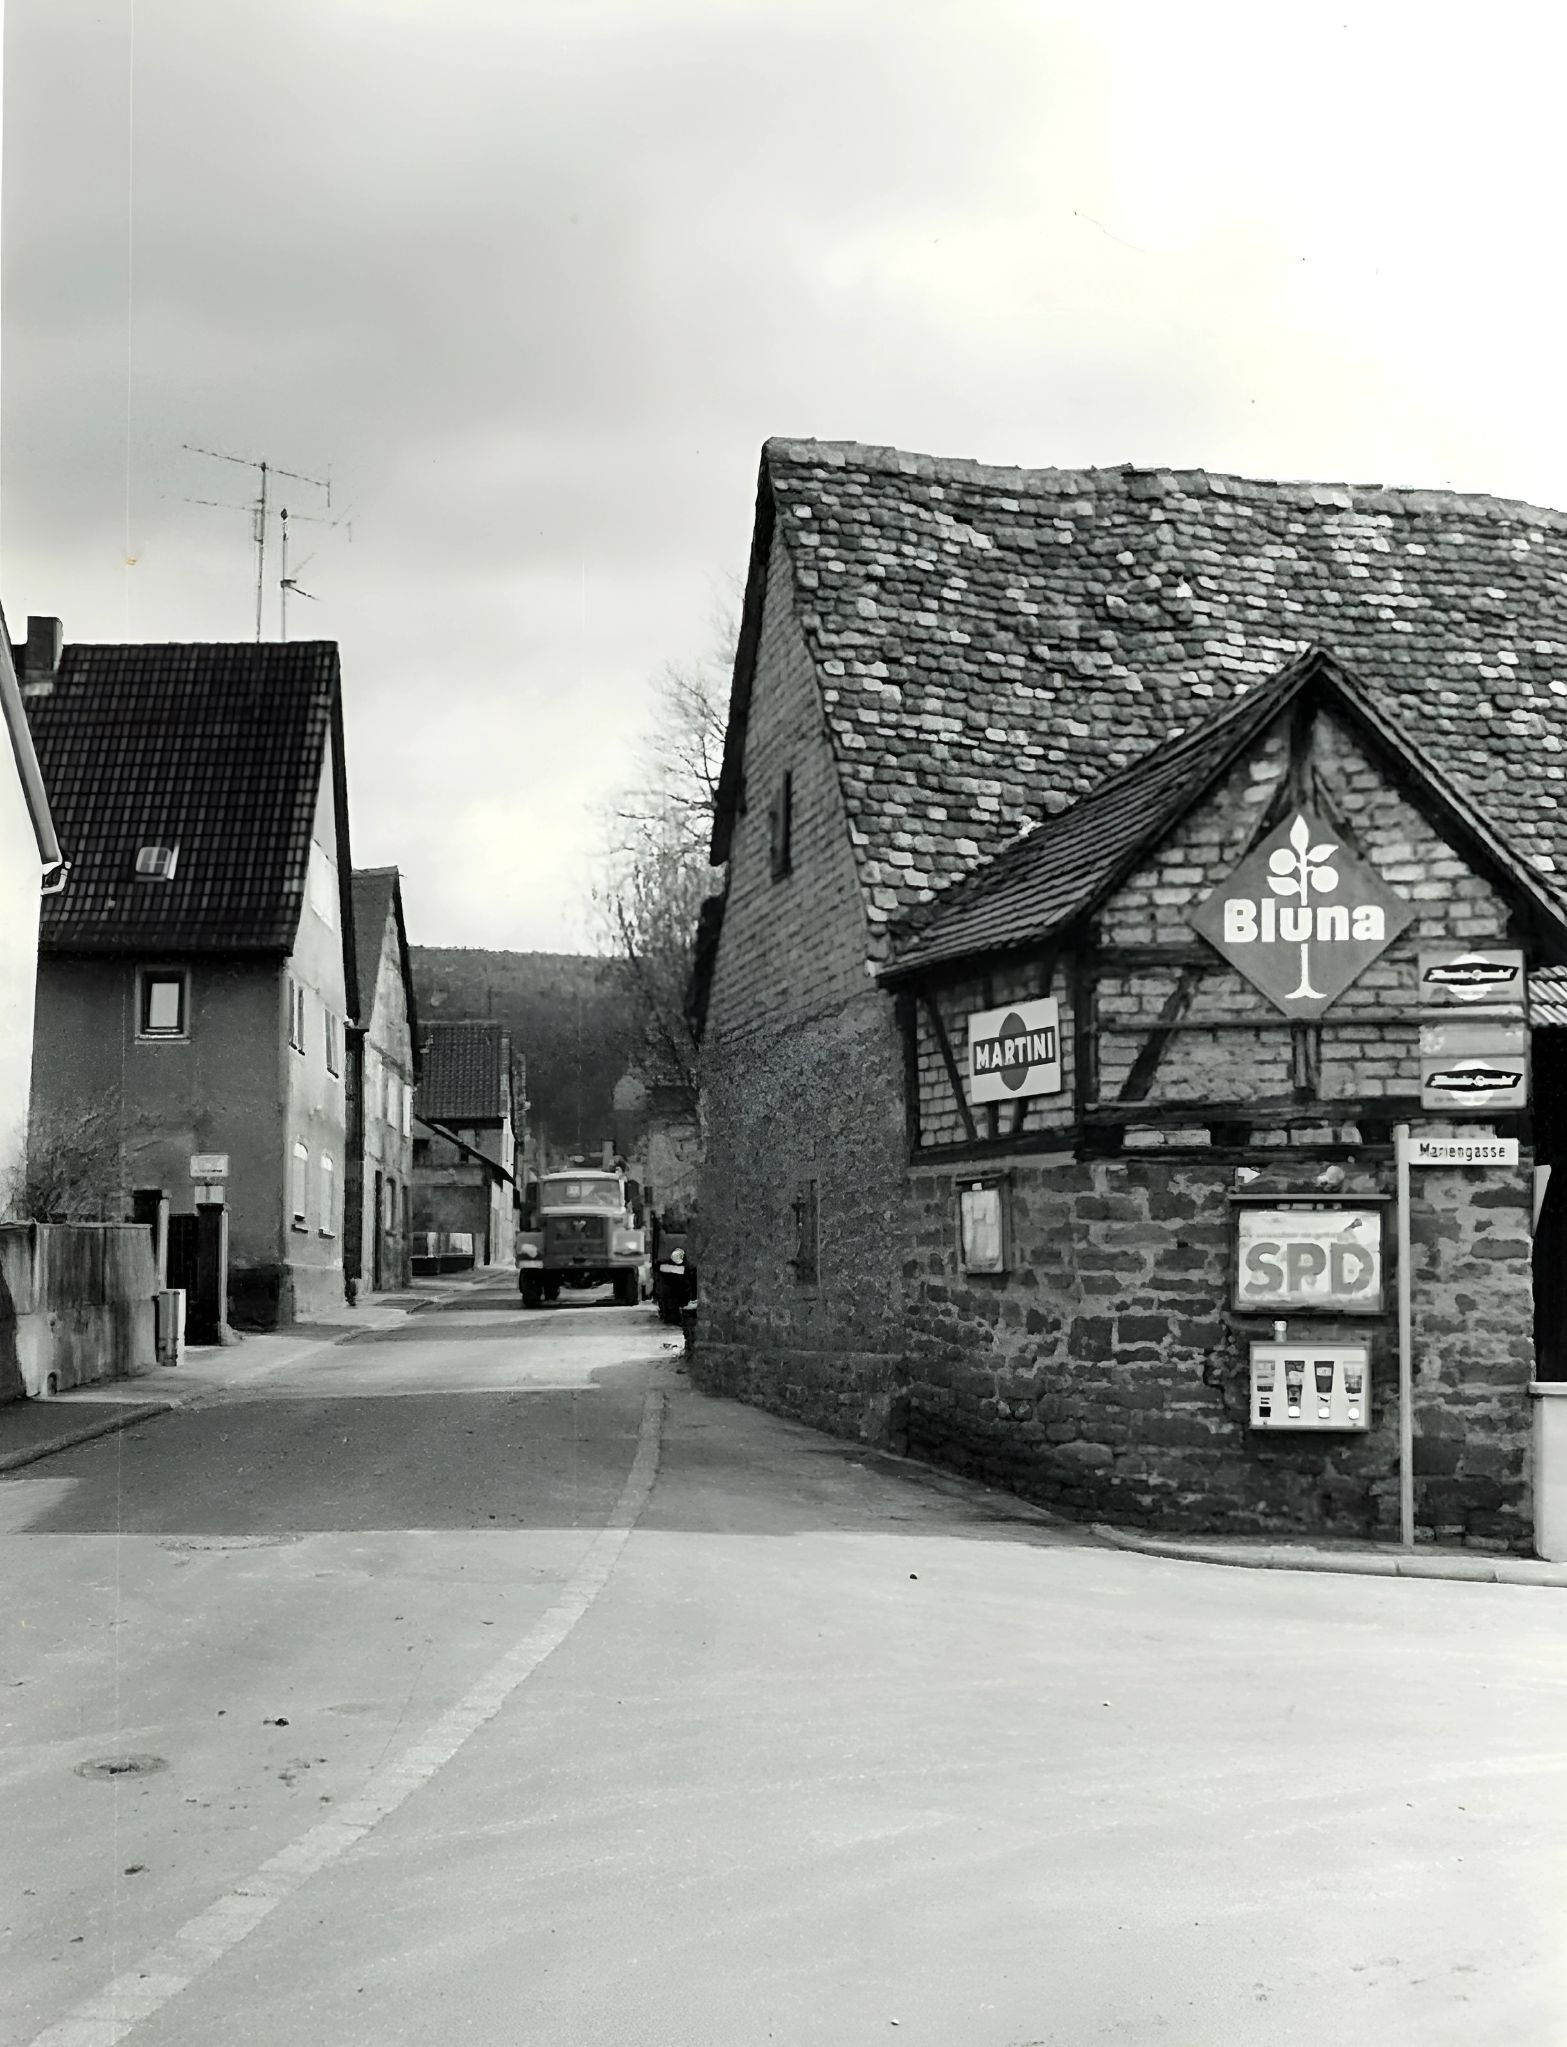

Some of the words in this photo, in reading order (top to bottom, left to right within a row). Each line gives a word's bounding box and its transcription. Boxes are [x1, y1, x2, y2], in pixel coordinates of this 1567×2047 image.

[1224, 898, 1385, 943] Bluna
[976, 1031, 1054, 1070] MARTINI
[1419, 1142, 1505, 1162] Mariengasse
[1243, 1242, 1374, 1295] SPD
